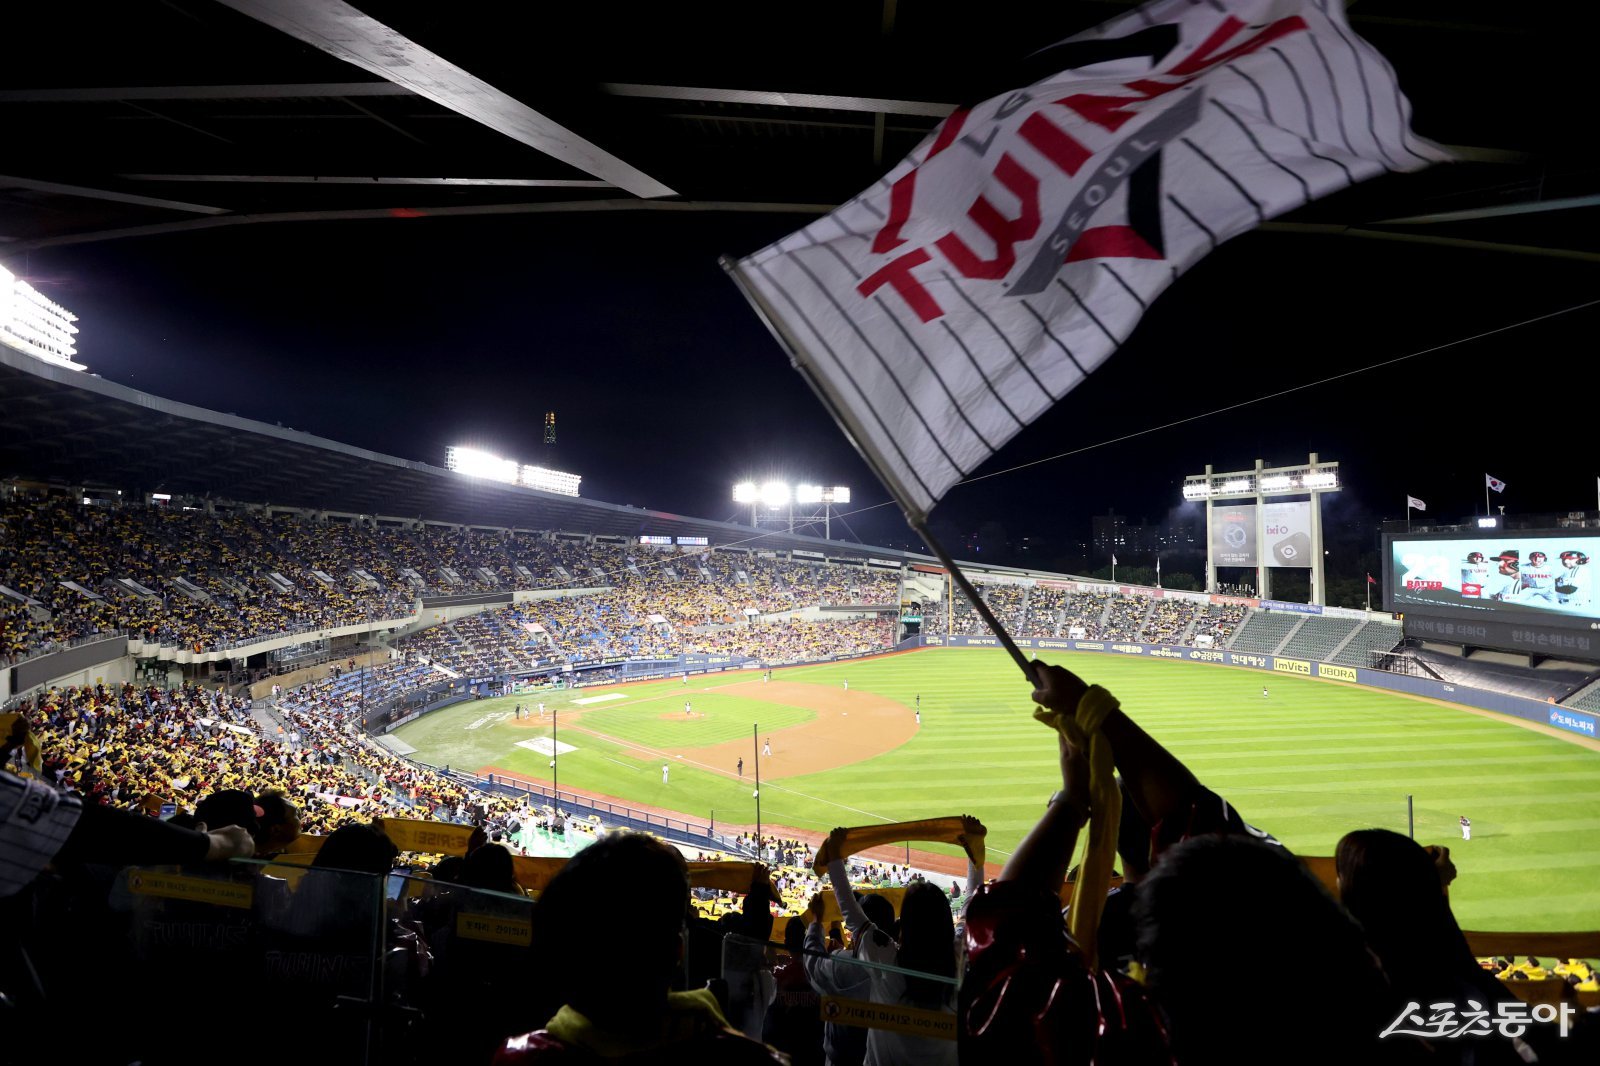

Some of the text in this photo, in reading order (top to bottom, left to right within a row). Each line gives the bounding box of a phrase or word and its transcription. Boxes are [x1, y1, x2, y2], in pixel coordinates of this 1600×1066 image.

[857, 76, 1200, 323] TWIN
[1050, 136, 1158, 255] SEOUL
[1408, 619, 1487, 638] 시작에 힘을 더하다
[1511, 629, 1590, 649] 한화손해보험
[1231, 653, 1266, 667] 현대해상
[1274, 660, 1310, 673] ImVita
[1319, 665, 1355, 680] UBORA
[1557, 716, 1595, 733] 도미노피자
[934, 1022, 954, 1031] NOT
